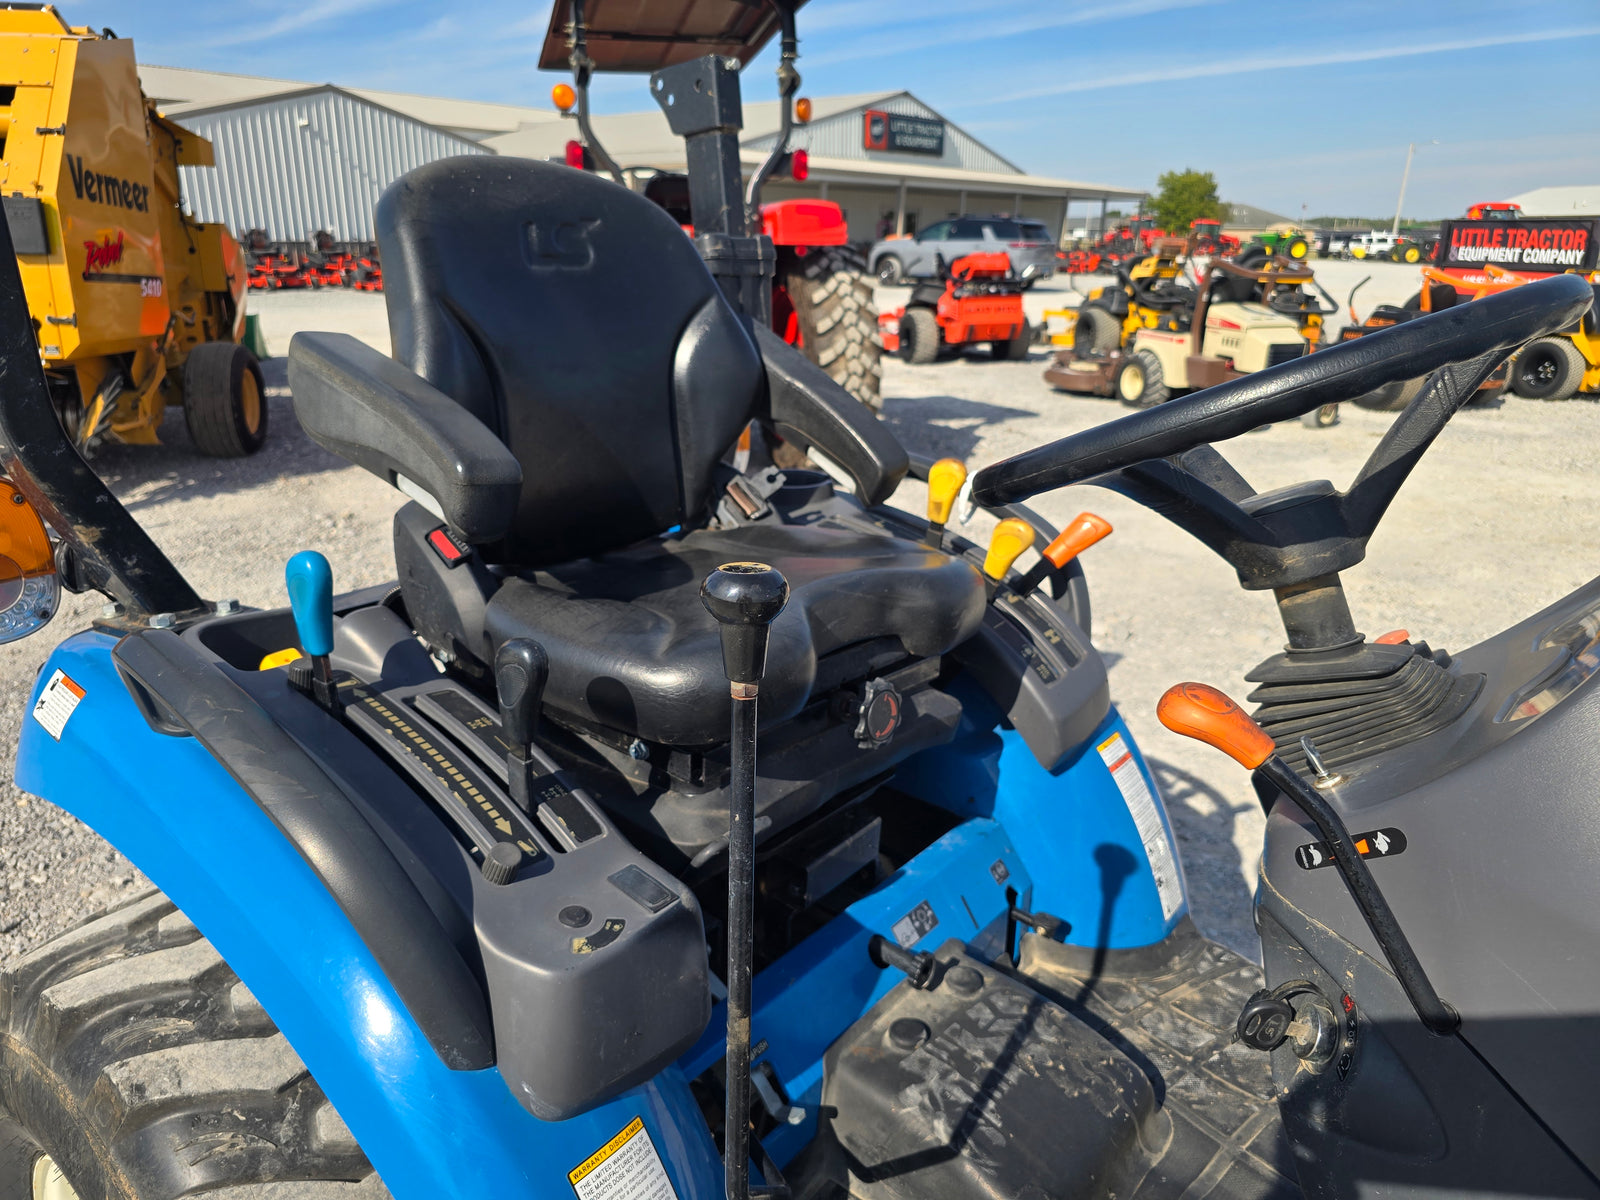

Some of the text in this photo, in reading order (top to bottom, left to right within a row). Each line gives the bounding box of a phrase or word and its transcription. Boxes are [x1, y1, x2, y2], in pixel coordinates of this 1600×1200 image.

[66, 153, 149, 213] Vermeer
[1451, 228, 1588, 251] LITTLE TRACTOR
[1457, 246, 1522, 263] EQUIPMENT
[1523, 247, 1585, 265] COMPANY
[572, 1121, 641, 1180] WARRANTY DISCLAIMER
[579, 1134, 644, 1191] THE LIMITED WARRANTY OF
[583, 1187, 594, 1199] THE
[594, 1154, 634, 1190] MANUFACTURER
[632, 1145, 642, 1157] FOR
[624, 1162, 634, 1174] NOT
